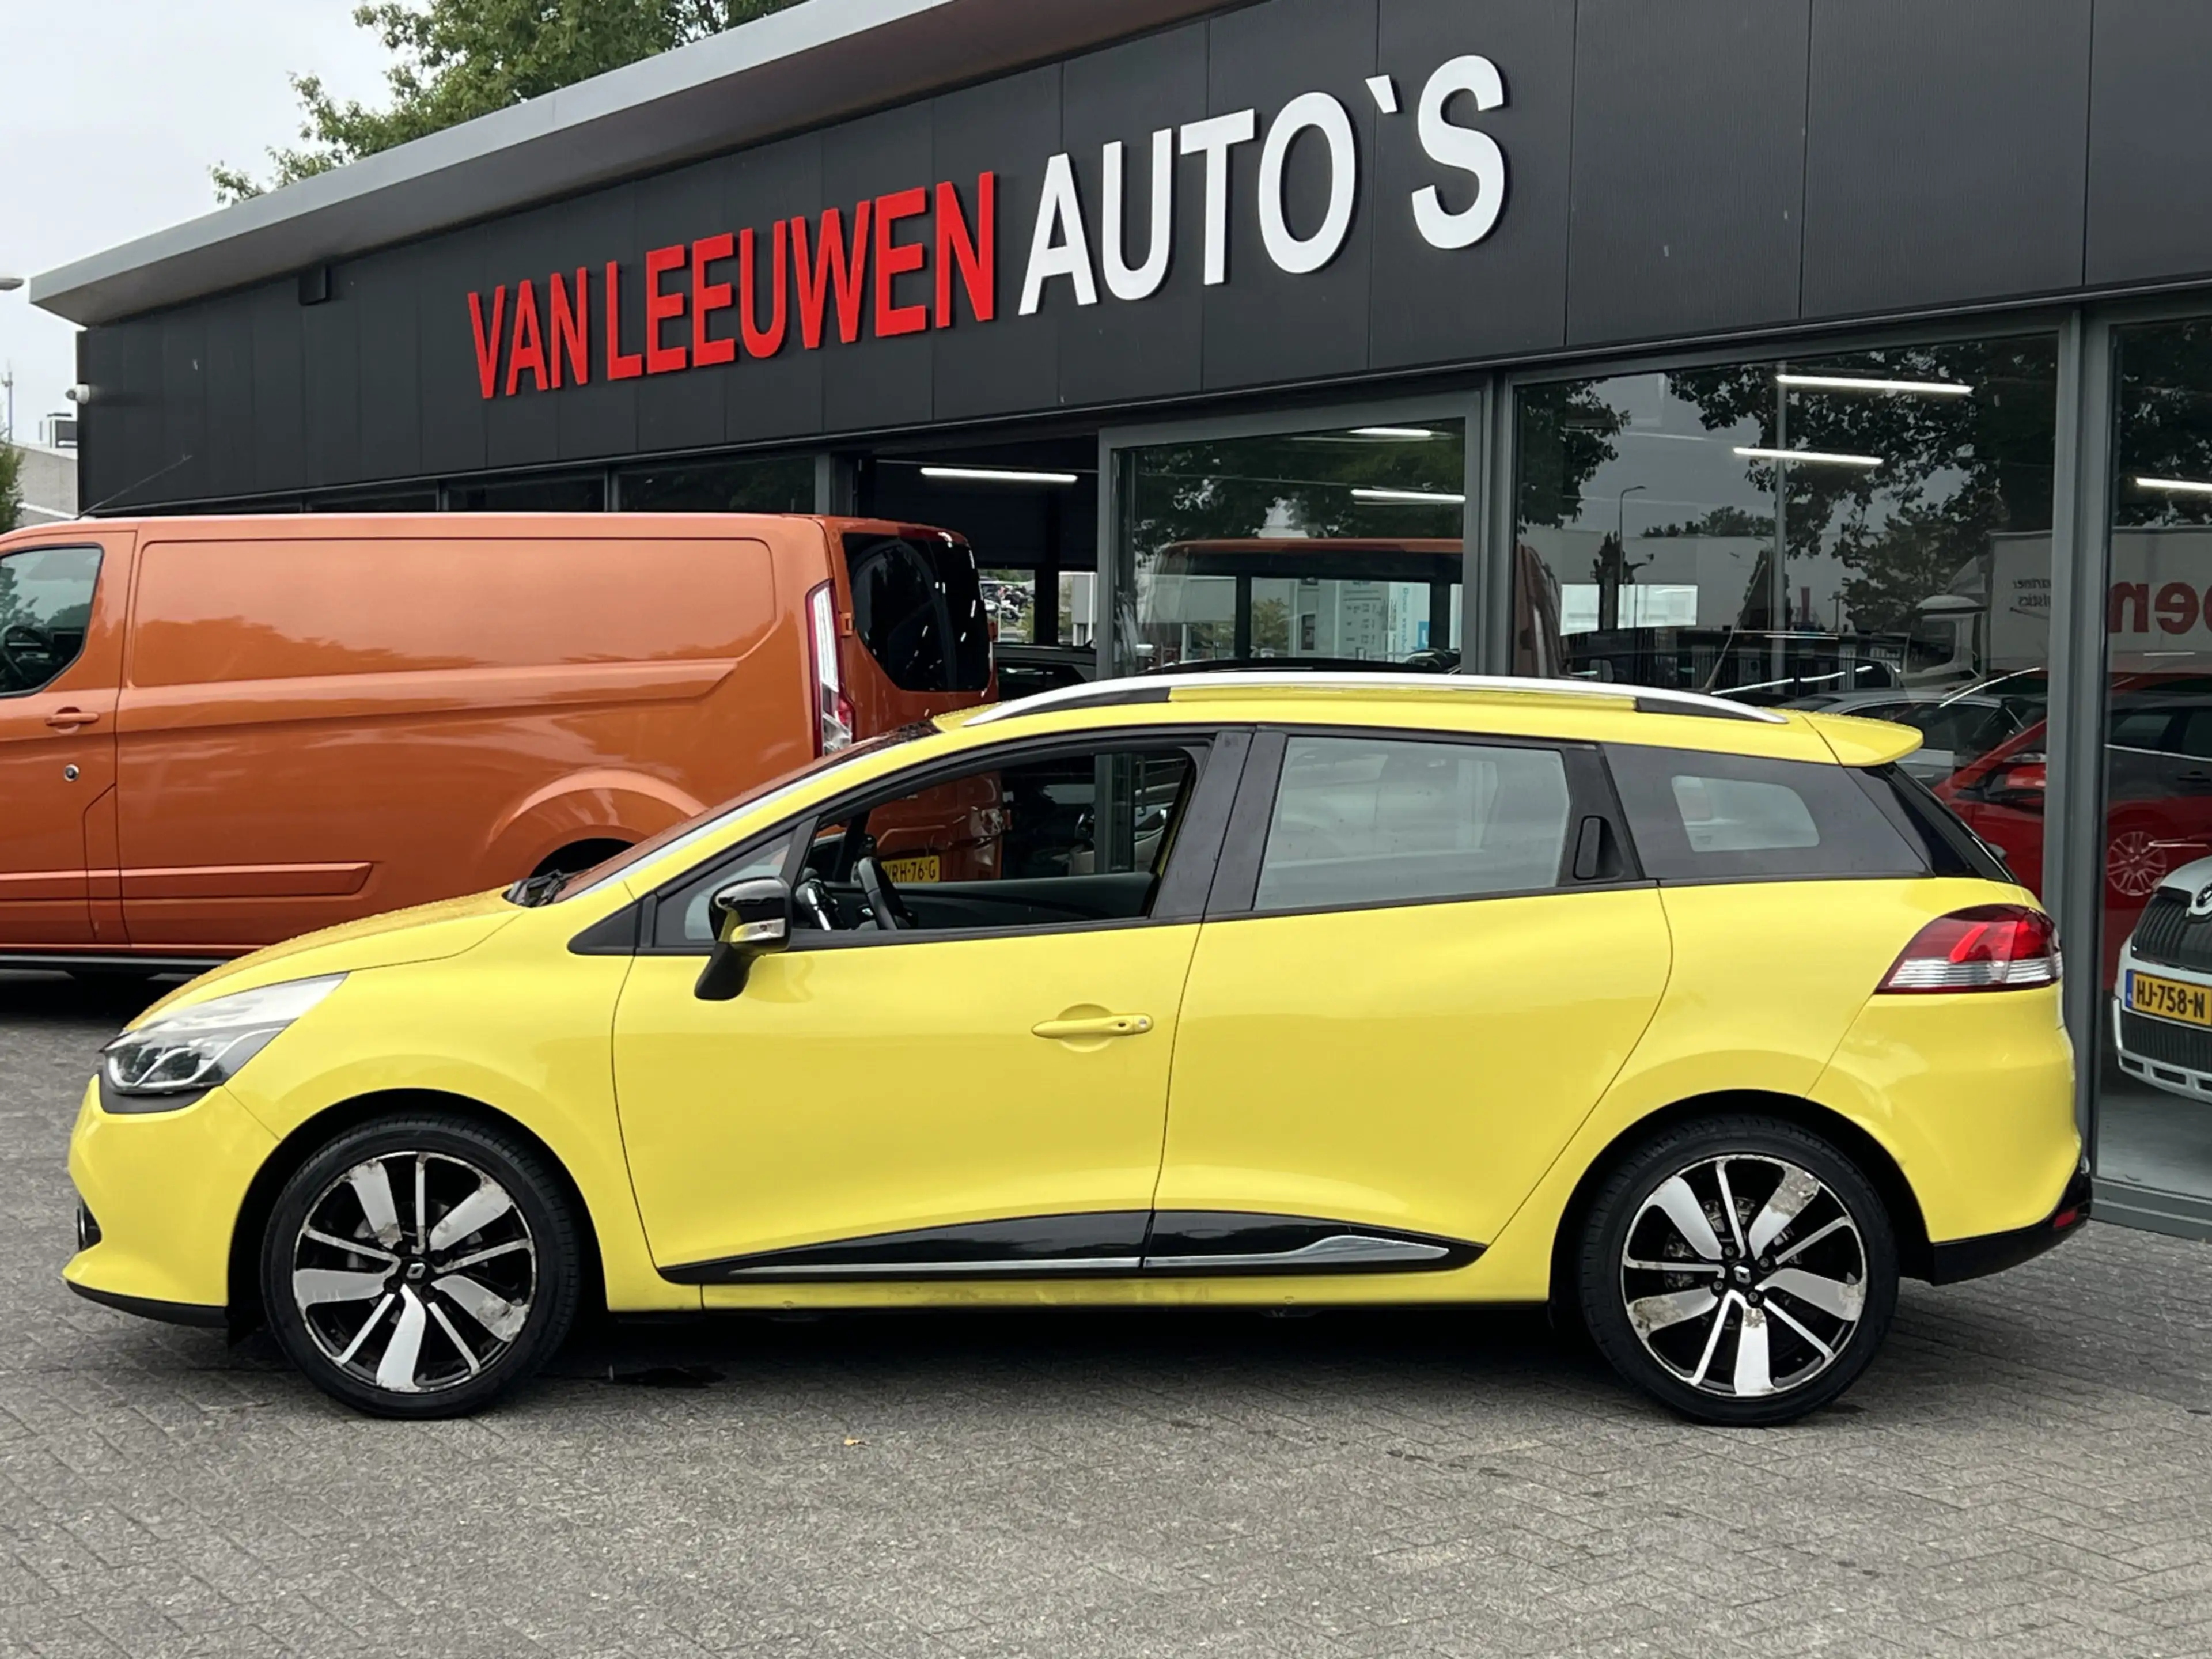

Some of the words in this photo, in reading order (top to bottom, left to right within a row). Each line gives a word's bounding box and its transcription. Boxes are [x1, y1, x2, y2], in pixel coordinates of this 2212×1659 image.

[468, 267, 588, 398] VAN
[607, 171, 994, 380] LEEUWEN
[2137, 980, 2205, 1019] HJ-758-N
